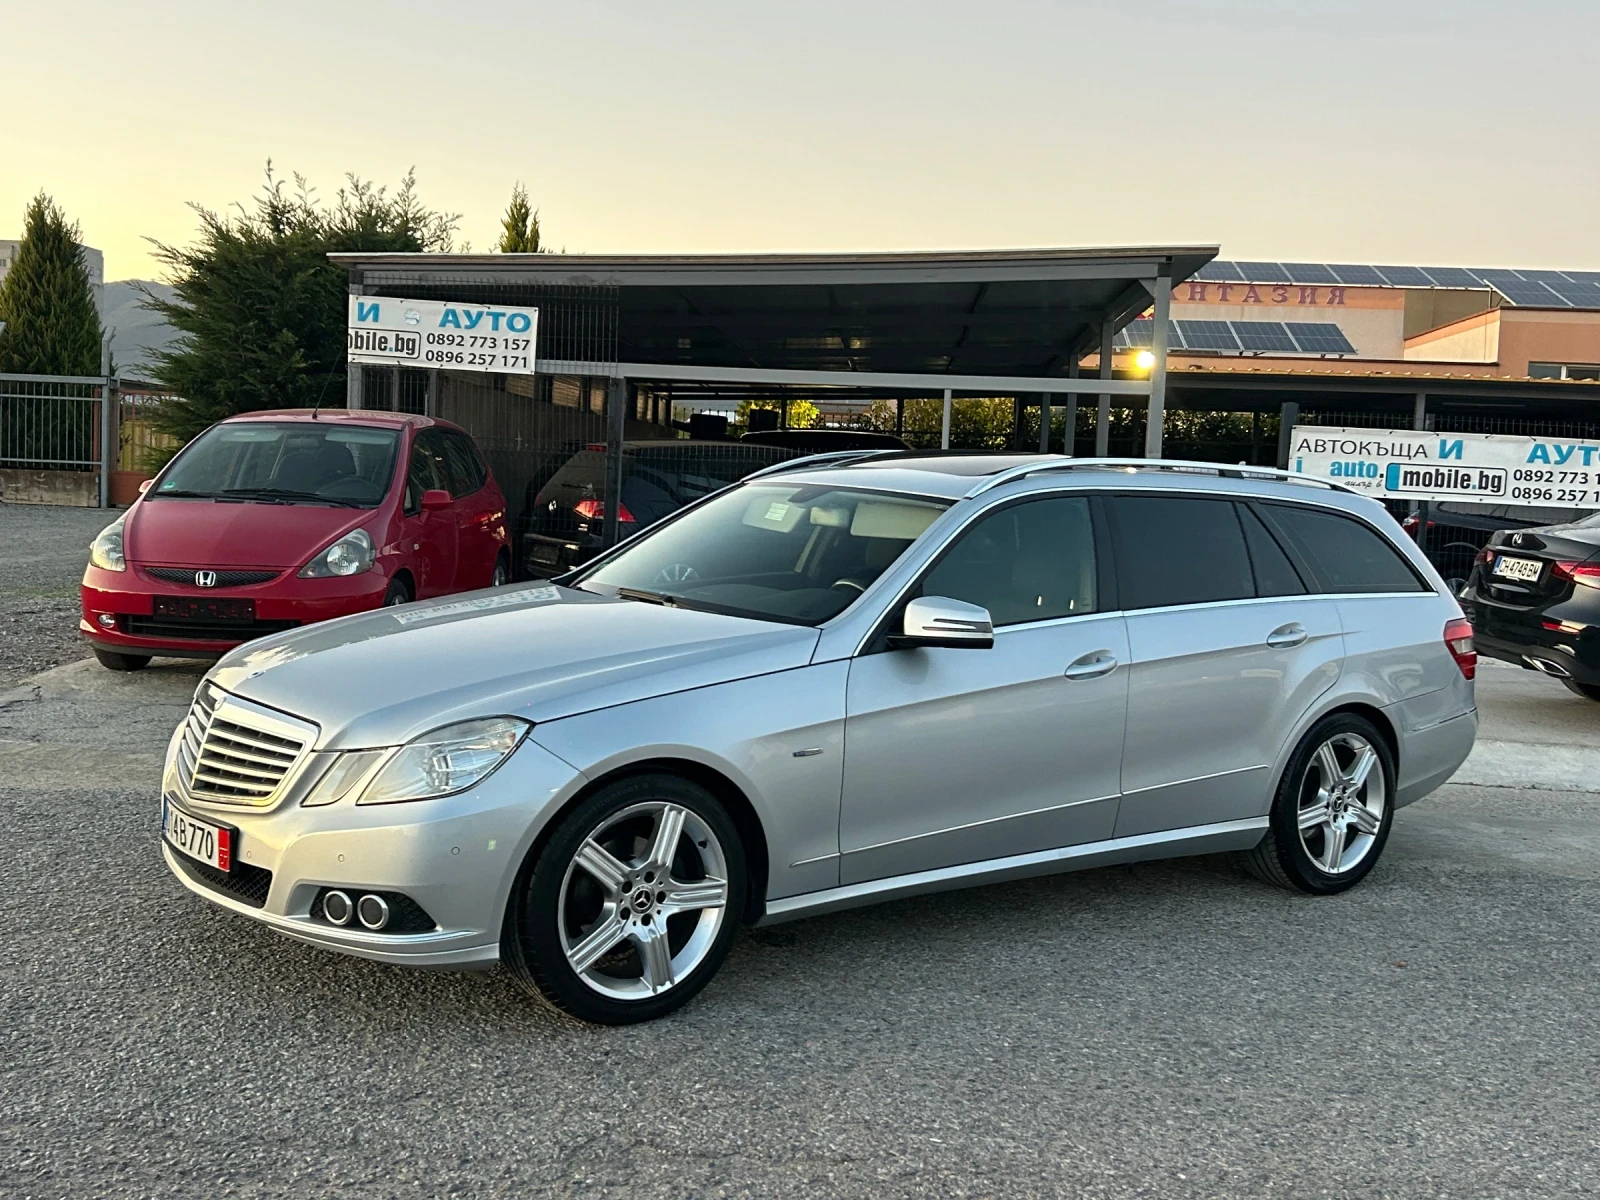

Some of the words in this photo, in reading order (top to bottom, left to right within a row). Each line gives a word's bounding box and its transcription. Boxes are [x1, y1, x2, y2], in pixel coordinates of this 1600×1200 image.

[357, 301, 380, 323] И
[438, 308, 532, 333] АУТО
[426, 332, 465, 347] 0892
[469, 335, 497, 349] 773
[502, 338, 531, 351] 157
[425, 349, 464, 364] 0896
[467, 352, 497, 366] 257
[501, 355, 528, 369] 171
[1296, 438, 1429, 460] АВТОКЪЩА
[1438, 438, 1464, 460] И
[1526, 443, 1600, 467] АУТ
[1402, 468, 1503, 494] mobile.bg
[1513, 469, 1554, 483] 0892
[1558, 471, 1589, 485] 773
[1511, 486, 1553, 501] 0896
[1556, 488, 1588, 502] 257
